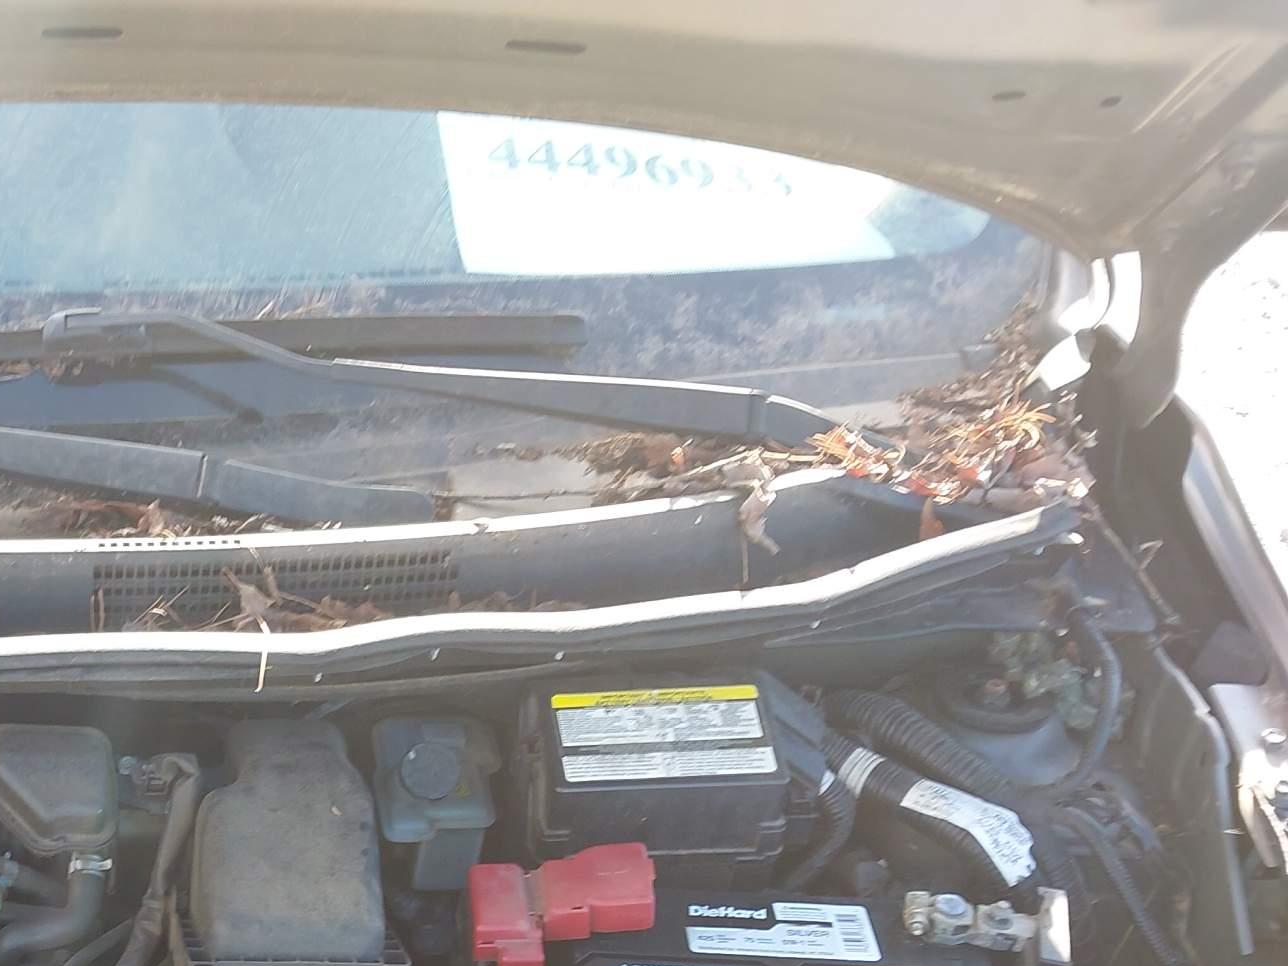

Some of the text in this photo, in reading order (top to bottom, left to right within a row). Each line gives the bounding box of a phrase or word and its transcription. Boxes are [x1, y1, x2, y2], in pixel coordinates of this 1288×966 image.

[487, 137, 792, 196] 444969
[687, 905, 768, 919] DieHard
[786, 928, 830, 938] SILVER
